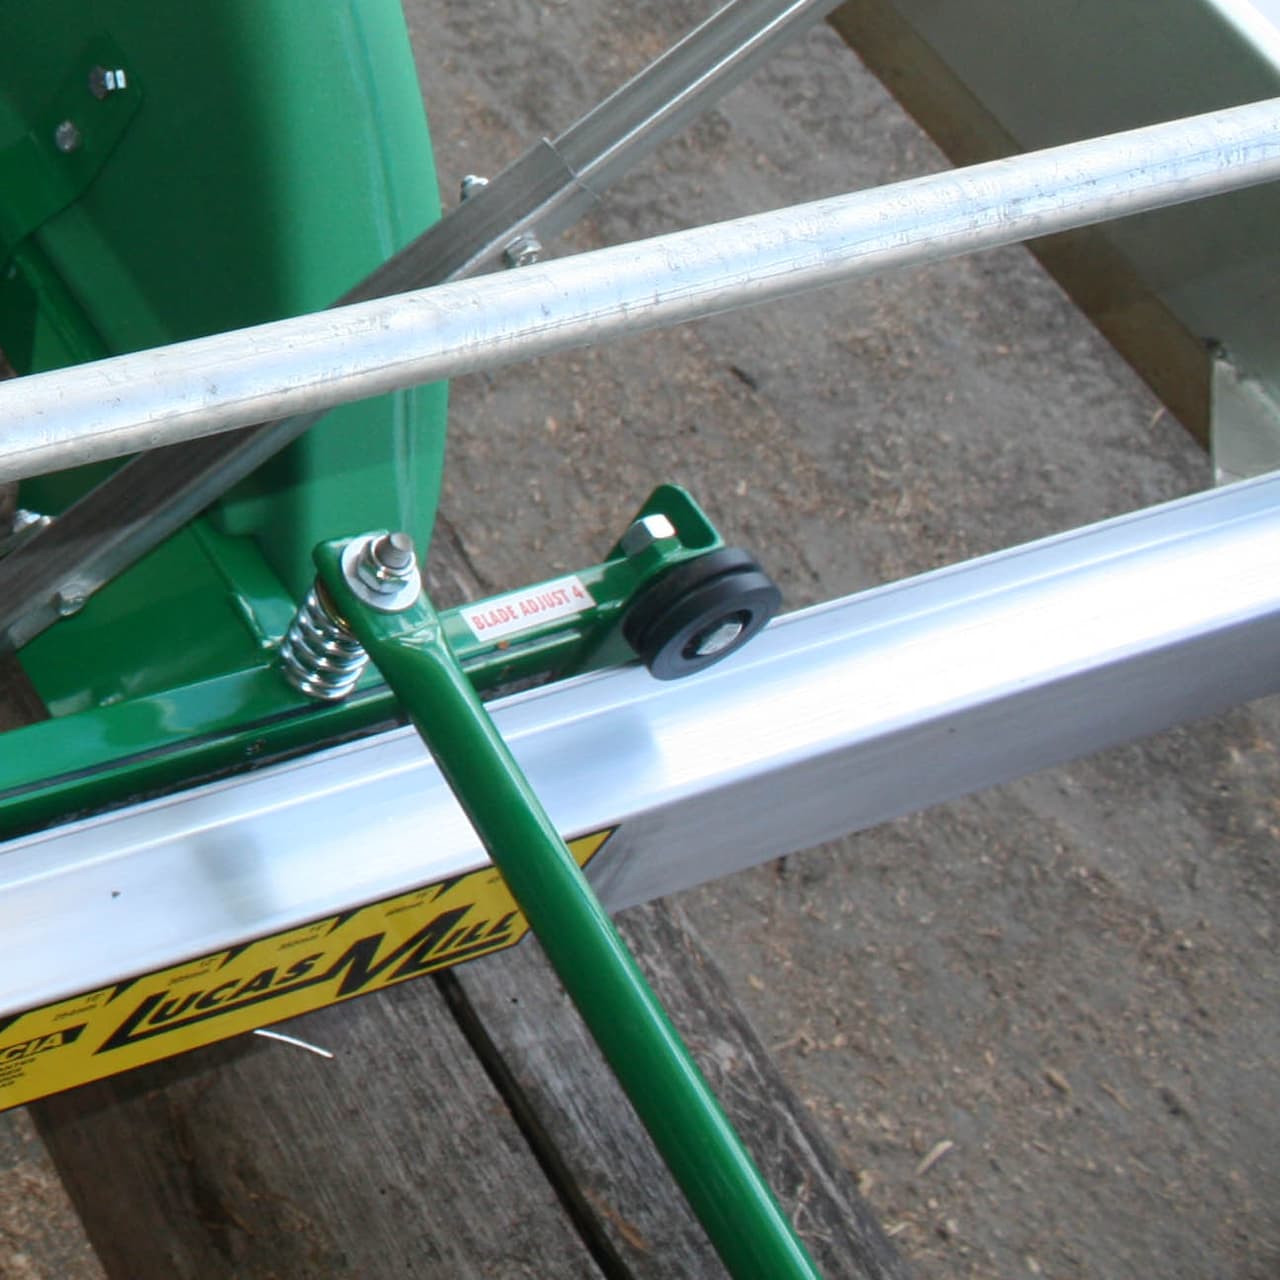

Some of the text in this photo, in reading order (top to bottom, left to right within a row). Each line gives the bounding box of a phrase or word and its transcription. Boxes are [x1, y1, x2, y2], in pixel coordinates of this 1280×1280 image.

[471, 584, 585, 631] BLADE ADJUST 4
[92, 903, 519, 1056] LUCAS MILL
